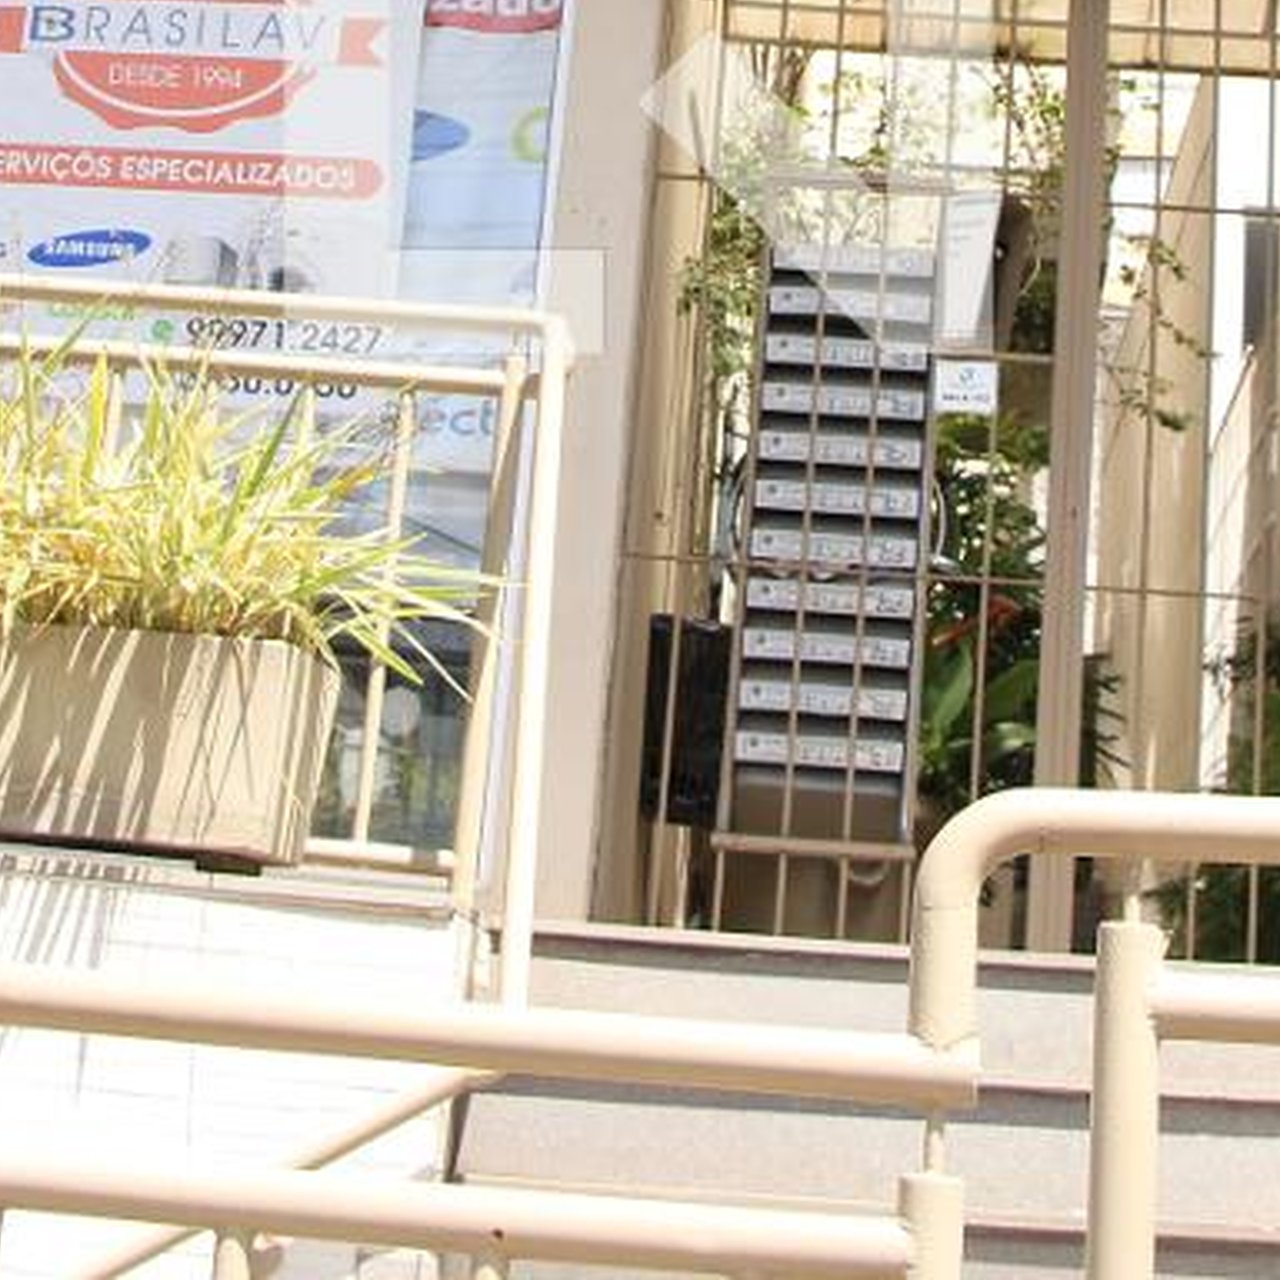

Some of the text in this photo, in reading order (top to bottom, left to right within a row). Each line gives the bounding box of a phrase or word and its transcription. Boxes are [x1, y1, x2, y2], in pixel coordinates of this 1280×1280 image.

[29, 6, 326, 50] BRASILAV
[108, 63, 243, 89] DESDE 1994
[120, 156, 356, 191] ESPECIALIZADOS
